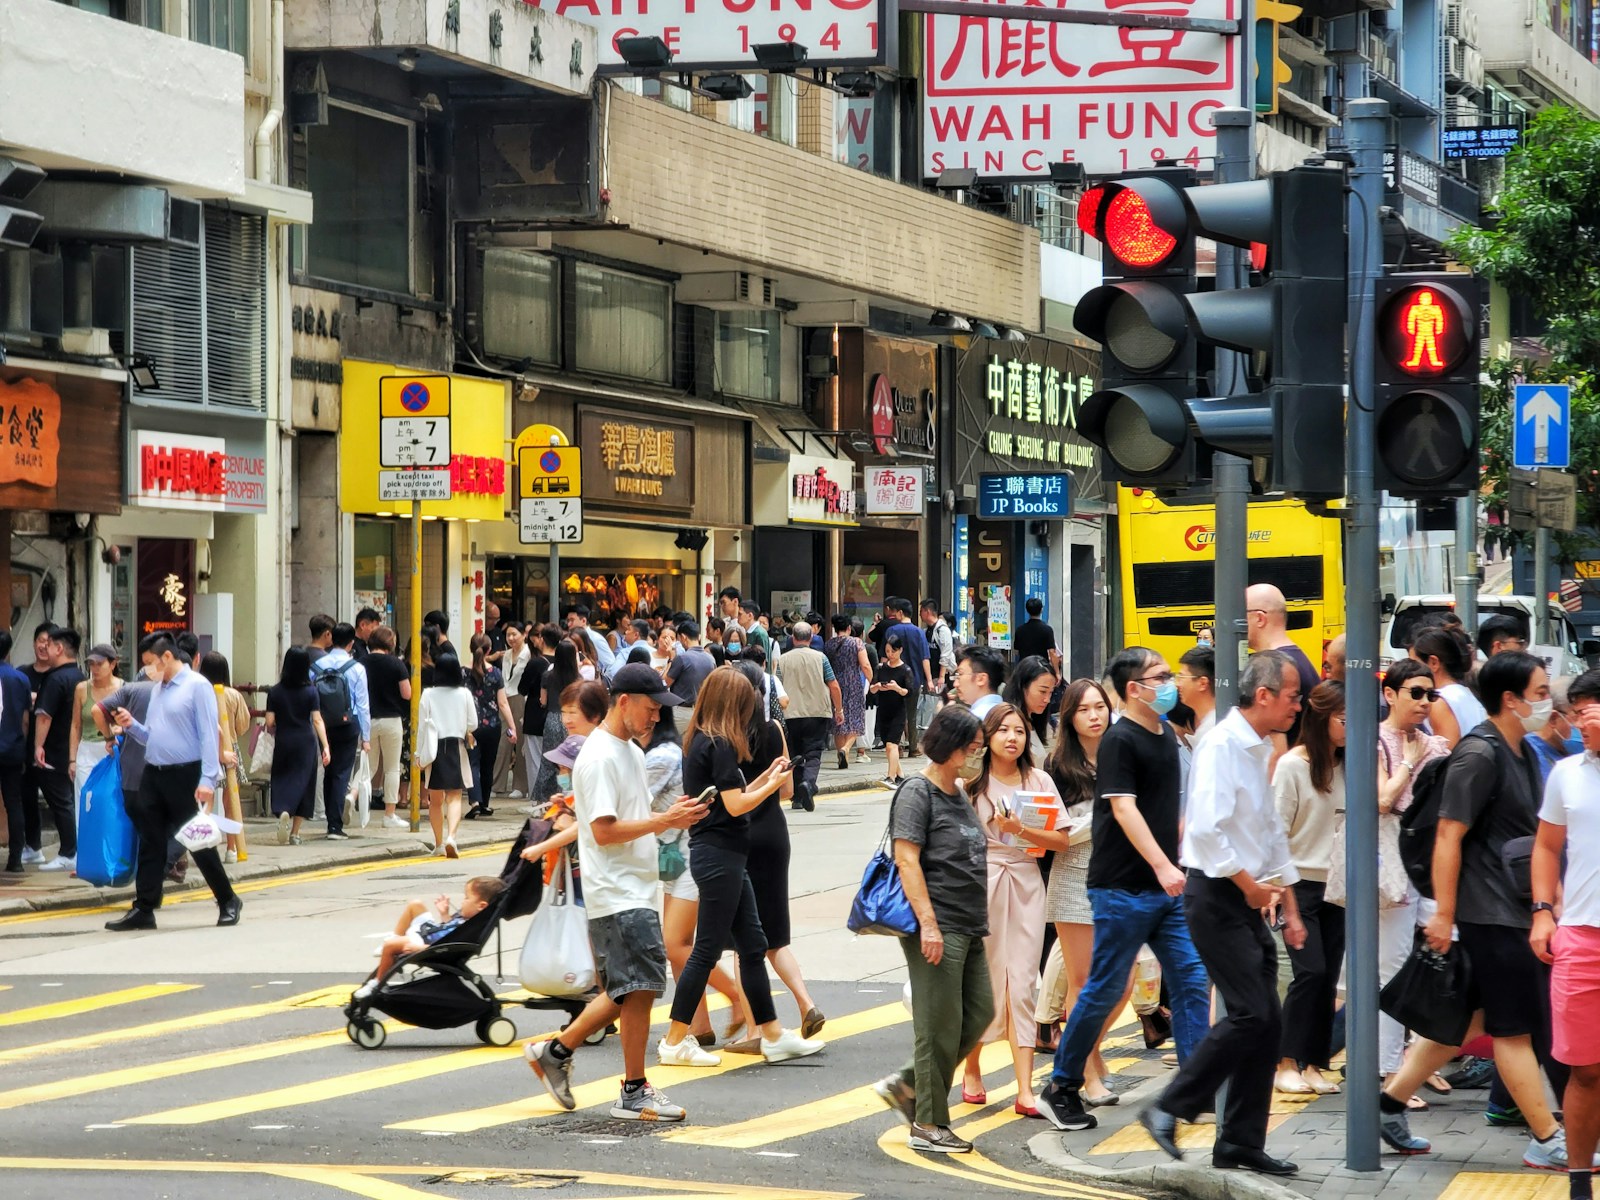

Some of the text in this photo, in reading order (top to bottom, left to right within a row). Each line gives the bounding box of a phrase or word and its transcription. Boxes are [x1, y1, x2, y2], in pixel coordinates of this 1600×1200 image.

[929, 103, 1051, 143] WAH
[1118, 146, 1201, 170] 194
[0, 404, 44, 450] 食堂
[395, 428, 415, 438] 上午
[426, 421, 437, 437] 7
[398, 446, 437, 462] pm 7
[988, 431, 1095, 468] CHUNG SHEUNG ART BUILDING
[395, 454, 416, 463] 下午
[387, 480, 401, 488] pick
[396, 473, 420, 481] Except
[383, 489, 446, 498] 的士上落客除外
[986, 476, 1062, 495] 三聯書店
[531, 508, 549, 516] 上午
[559, 501, 569, 515] 7
[990, 496, 1059, 514] JP Books
[523, 523, 578, 540] midnight 12
[531, 532, 549, 541] 午夜
